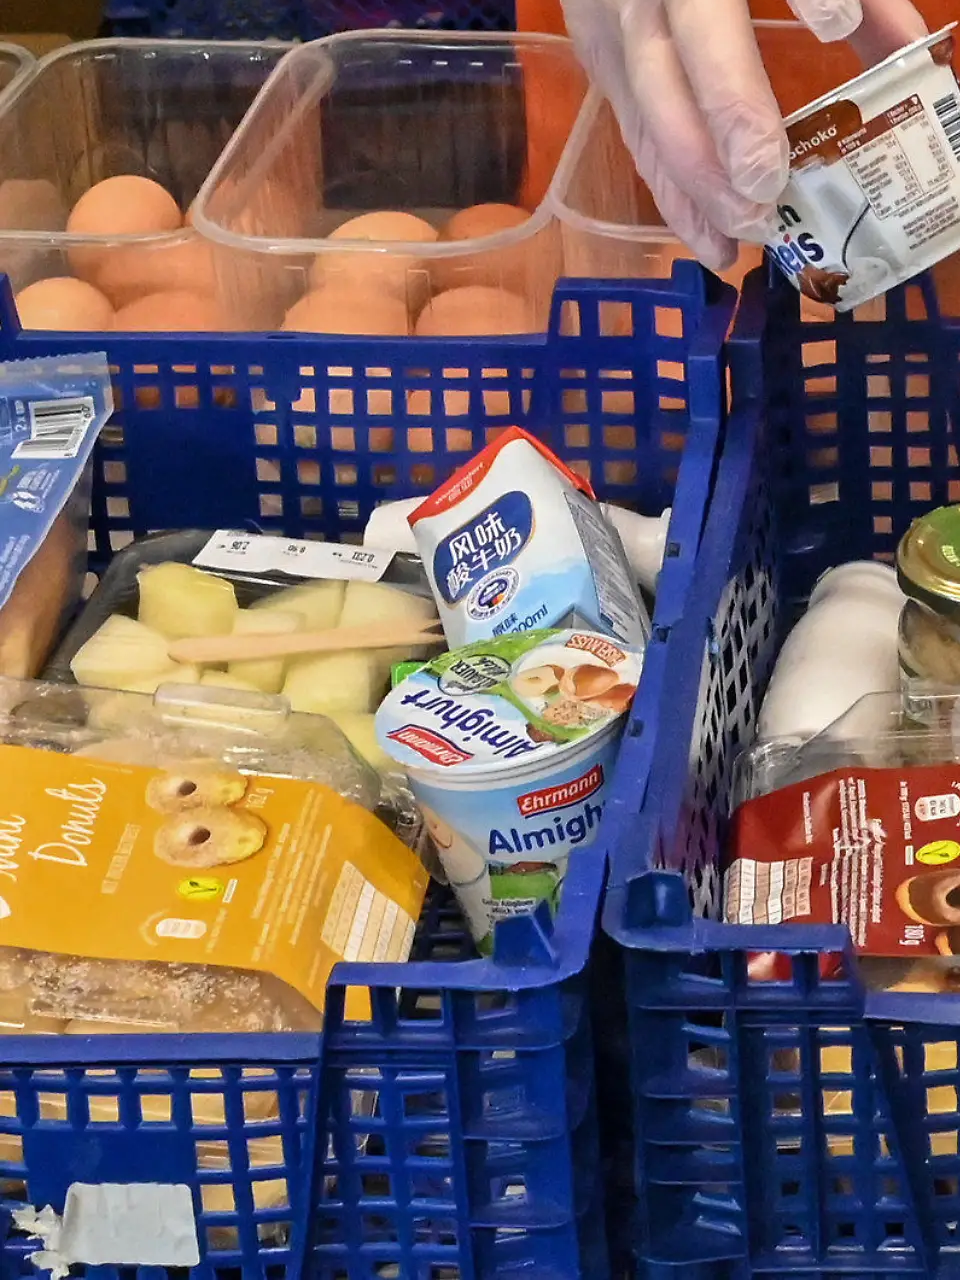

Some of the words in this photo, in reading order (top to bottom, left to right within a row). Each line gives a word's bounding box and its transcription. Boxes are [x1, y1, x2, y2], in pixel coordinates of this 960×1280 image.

[446, 526, 523, 599] 酸牛奶
[448, 509, 506, 563] 风味
[400, 688, 544, 760] Almighurt
[28, 776, 107, 867] Donuts
[521, 771, 599, 812] Ehrmann
[489, 801, 603, 855] Almigh
